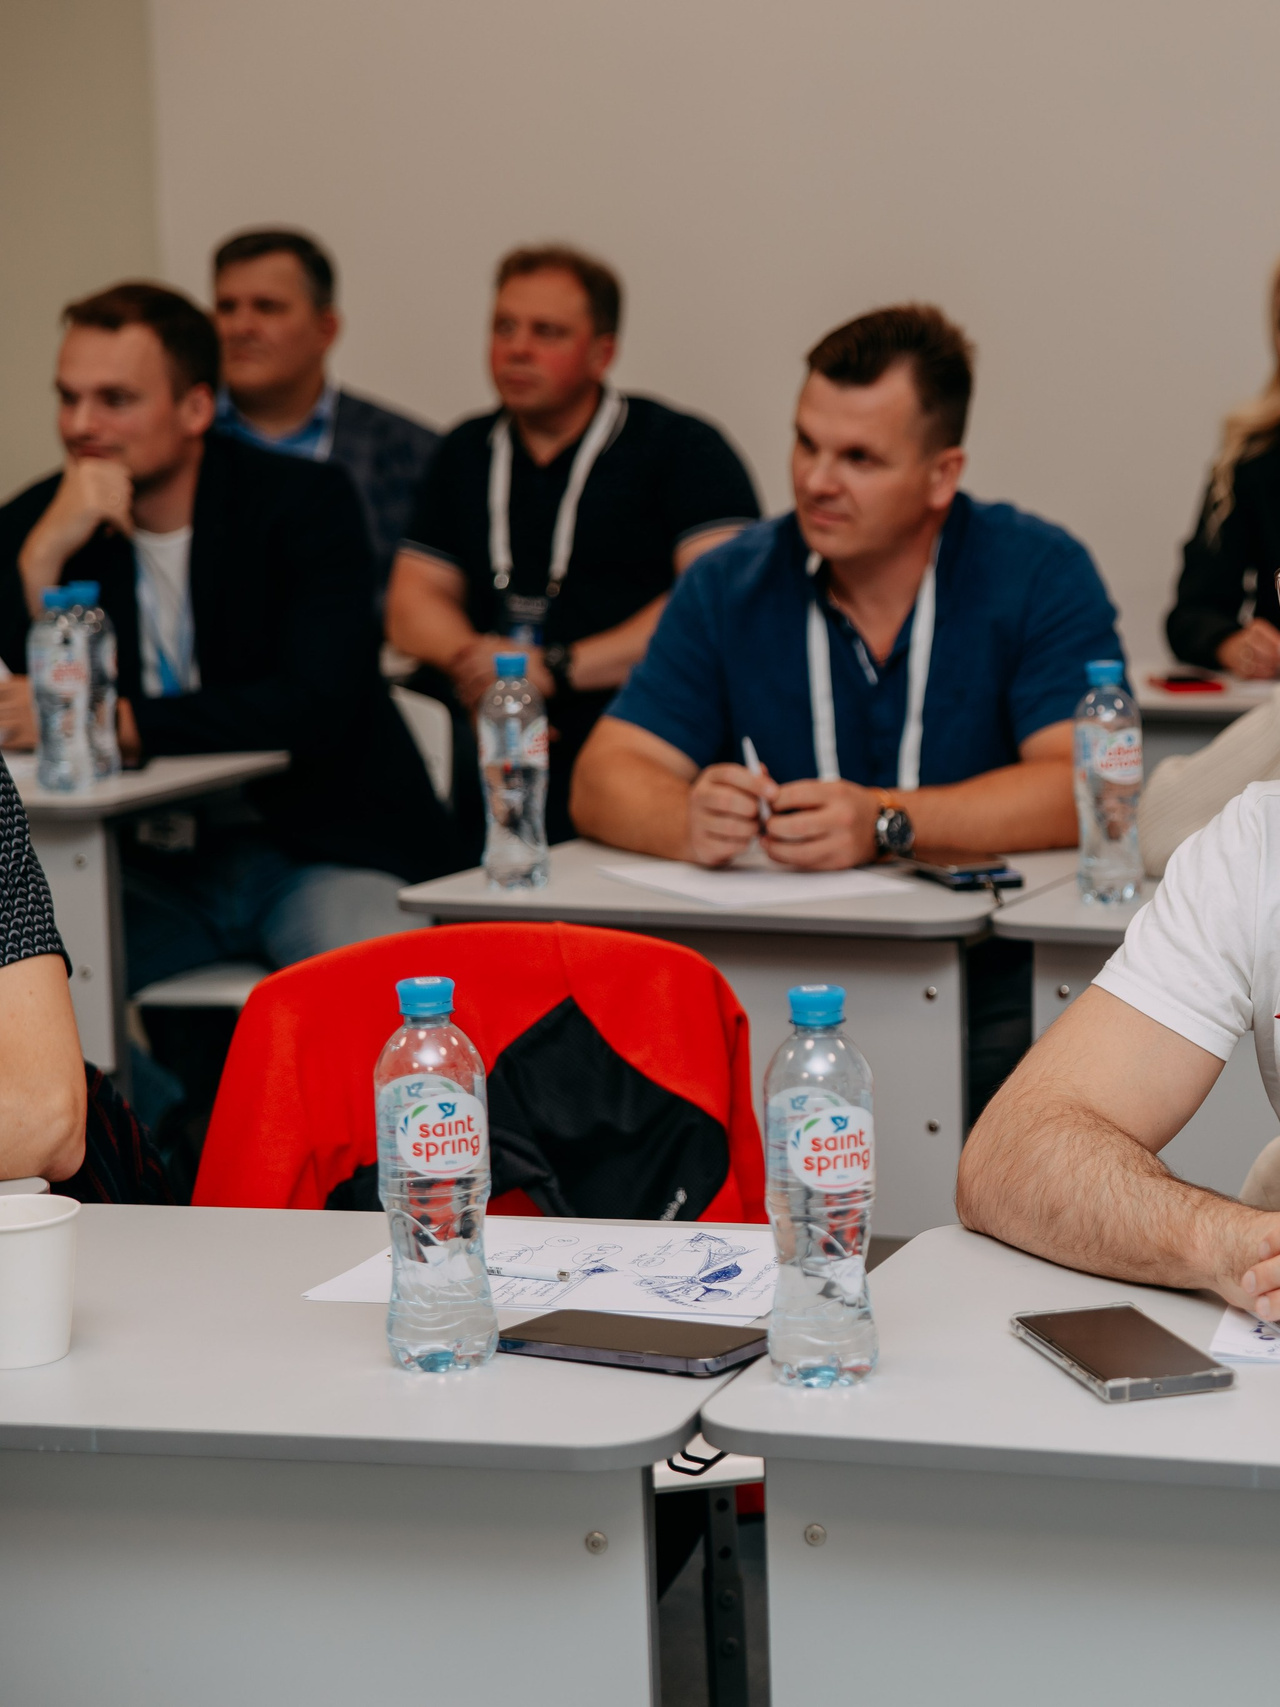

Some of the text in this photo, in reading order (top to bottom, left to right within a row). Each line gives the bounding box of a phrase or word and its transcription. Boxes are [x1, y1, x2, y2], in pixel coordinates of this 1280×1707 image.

[418, 1114, 475, 1139] saint
[411, 1134, 480, 1163] spring
[810, 1128, 865, 1153] saint
[803, 1148, 870, 1177] spring
